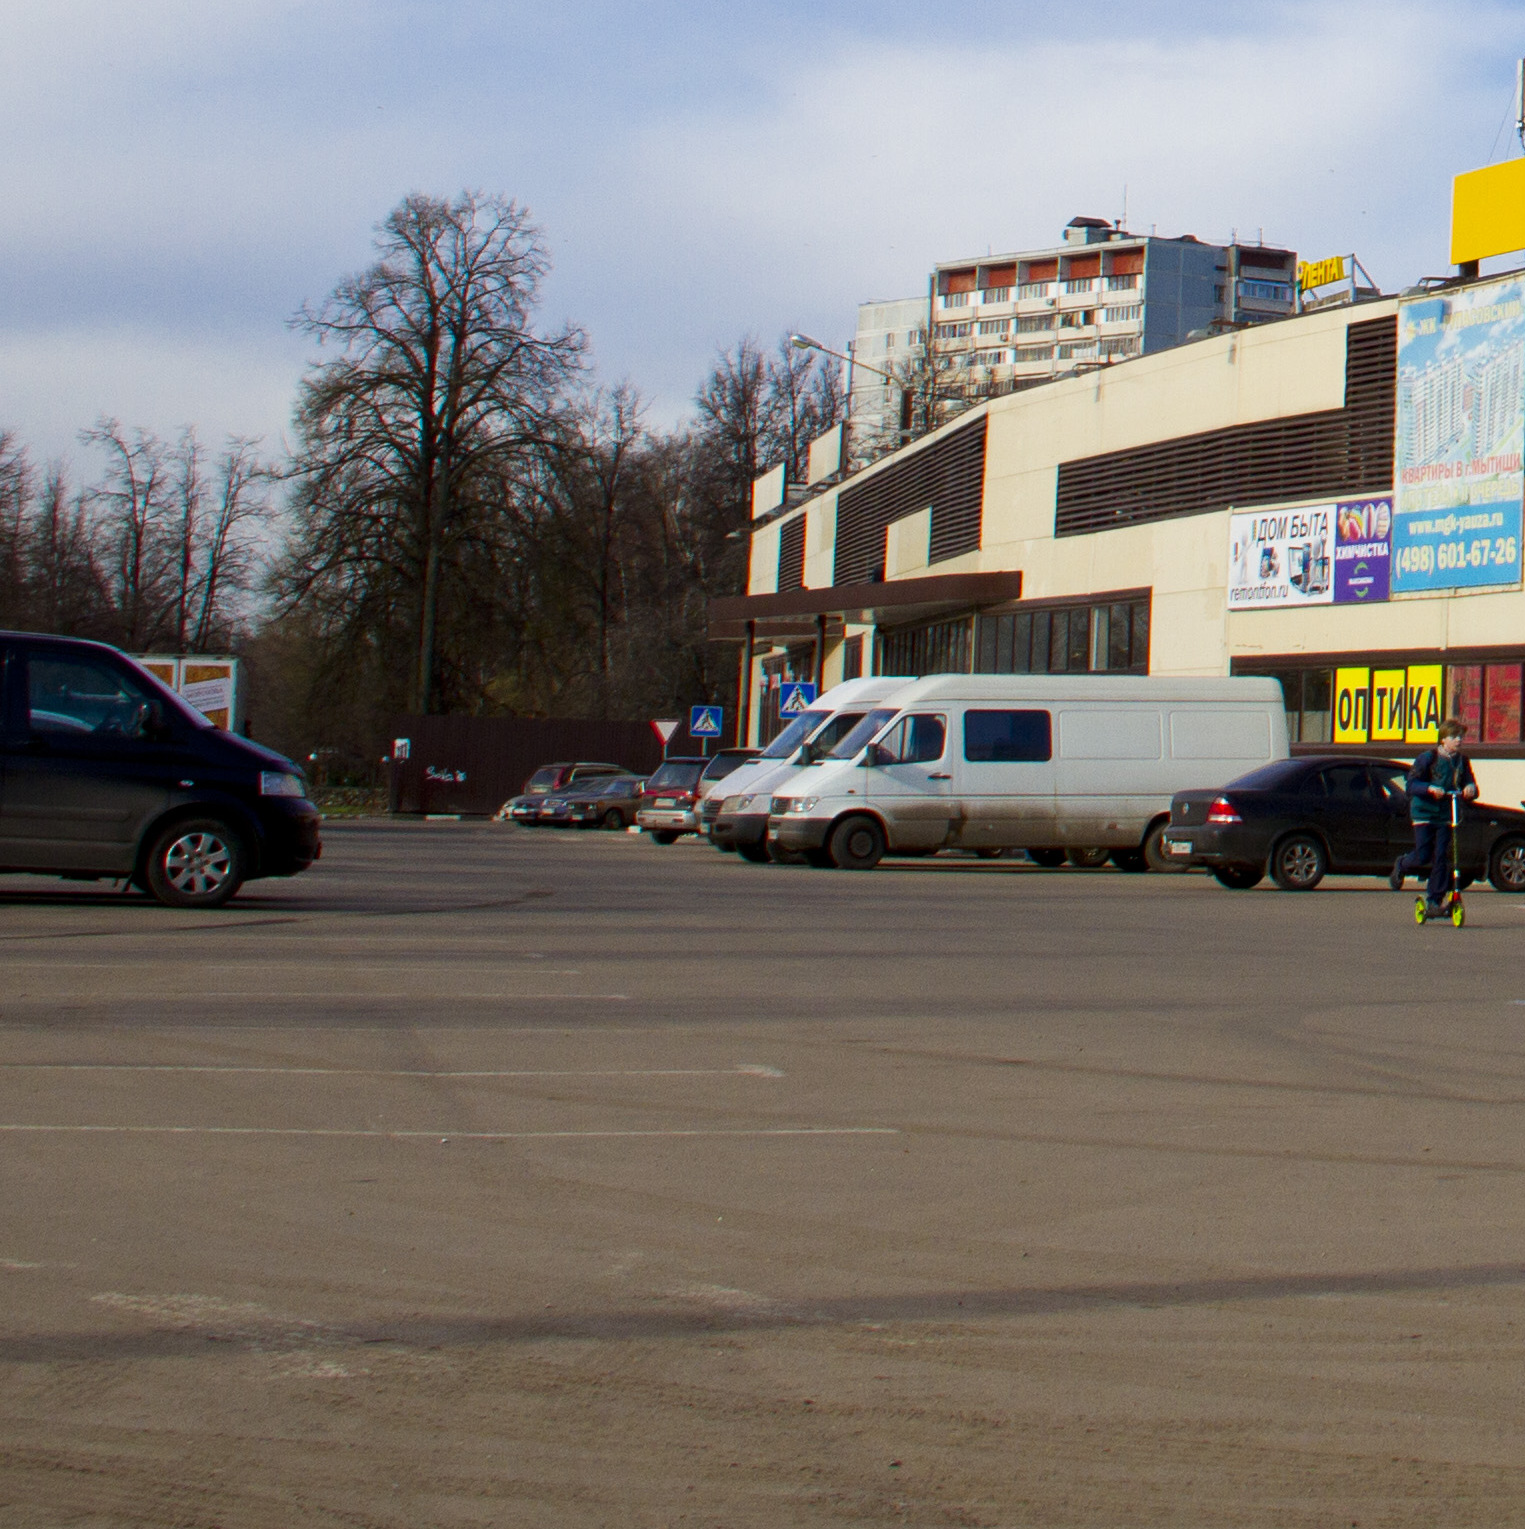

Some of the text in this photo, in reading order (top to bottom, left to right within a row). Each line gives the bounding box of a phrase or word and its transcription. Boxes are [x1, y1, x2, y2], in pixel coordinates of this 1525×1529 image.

[1301, 256, 1344, 290] ЛЕНТА
[1401, 462, 1453, 484] КВАРТИРЫ
[1257, 511, 1329, 547] ДОМ БЫТА
[1336, 541, 1389, 560] ХИМЧИСТКА
[1395, 536, 1517, 579] (498) 601-67-26
[1338, 684, 1442, 732] ОПТИКА
